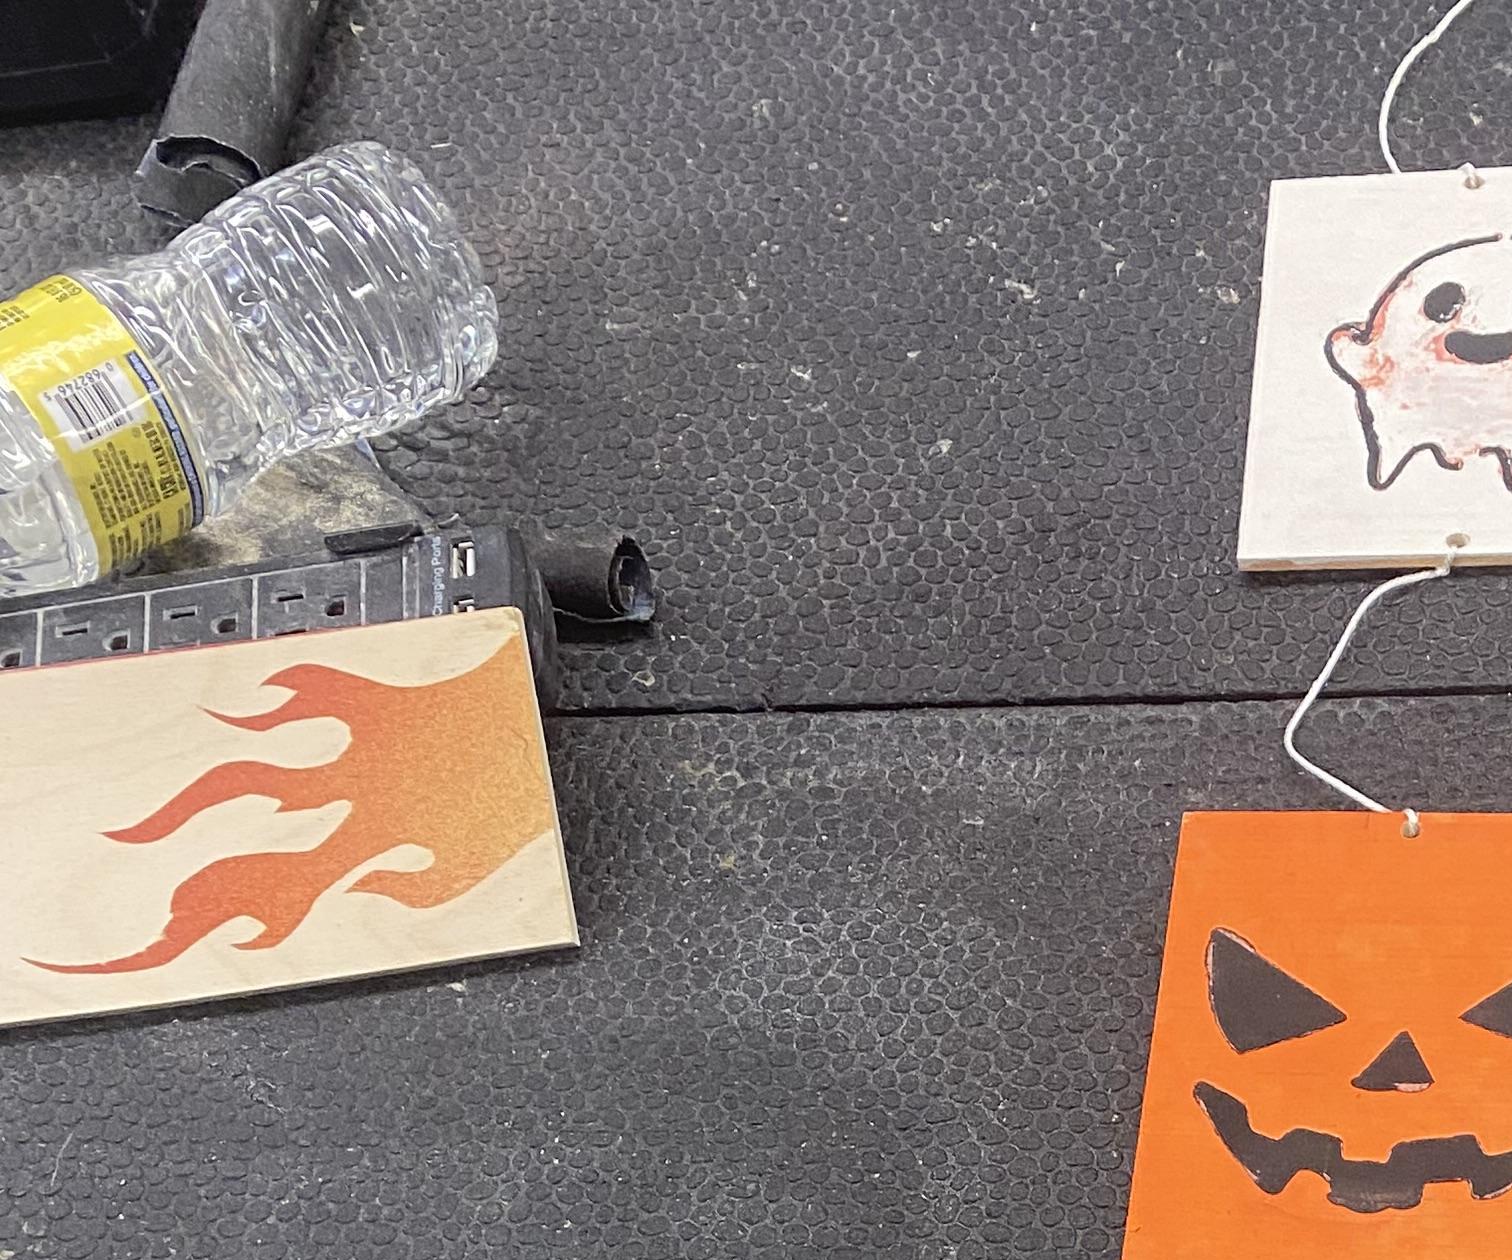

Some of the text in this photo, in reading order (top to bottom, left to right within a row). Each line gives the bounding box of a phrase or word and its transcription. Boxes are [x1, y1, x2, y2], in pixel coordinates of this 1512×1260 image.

[105, 362, 114, 372] 0
[57, 368, 101, 396] 682746
[431, 536, 446, 616] Charging Ports
